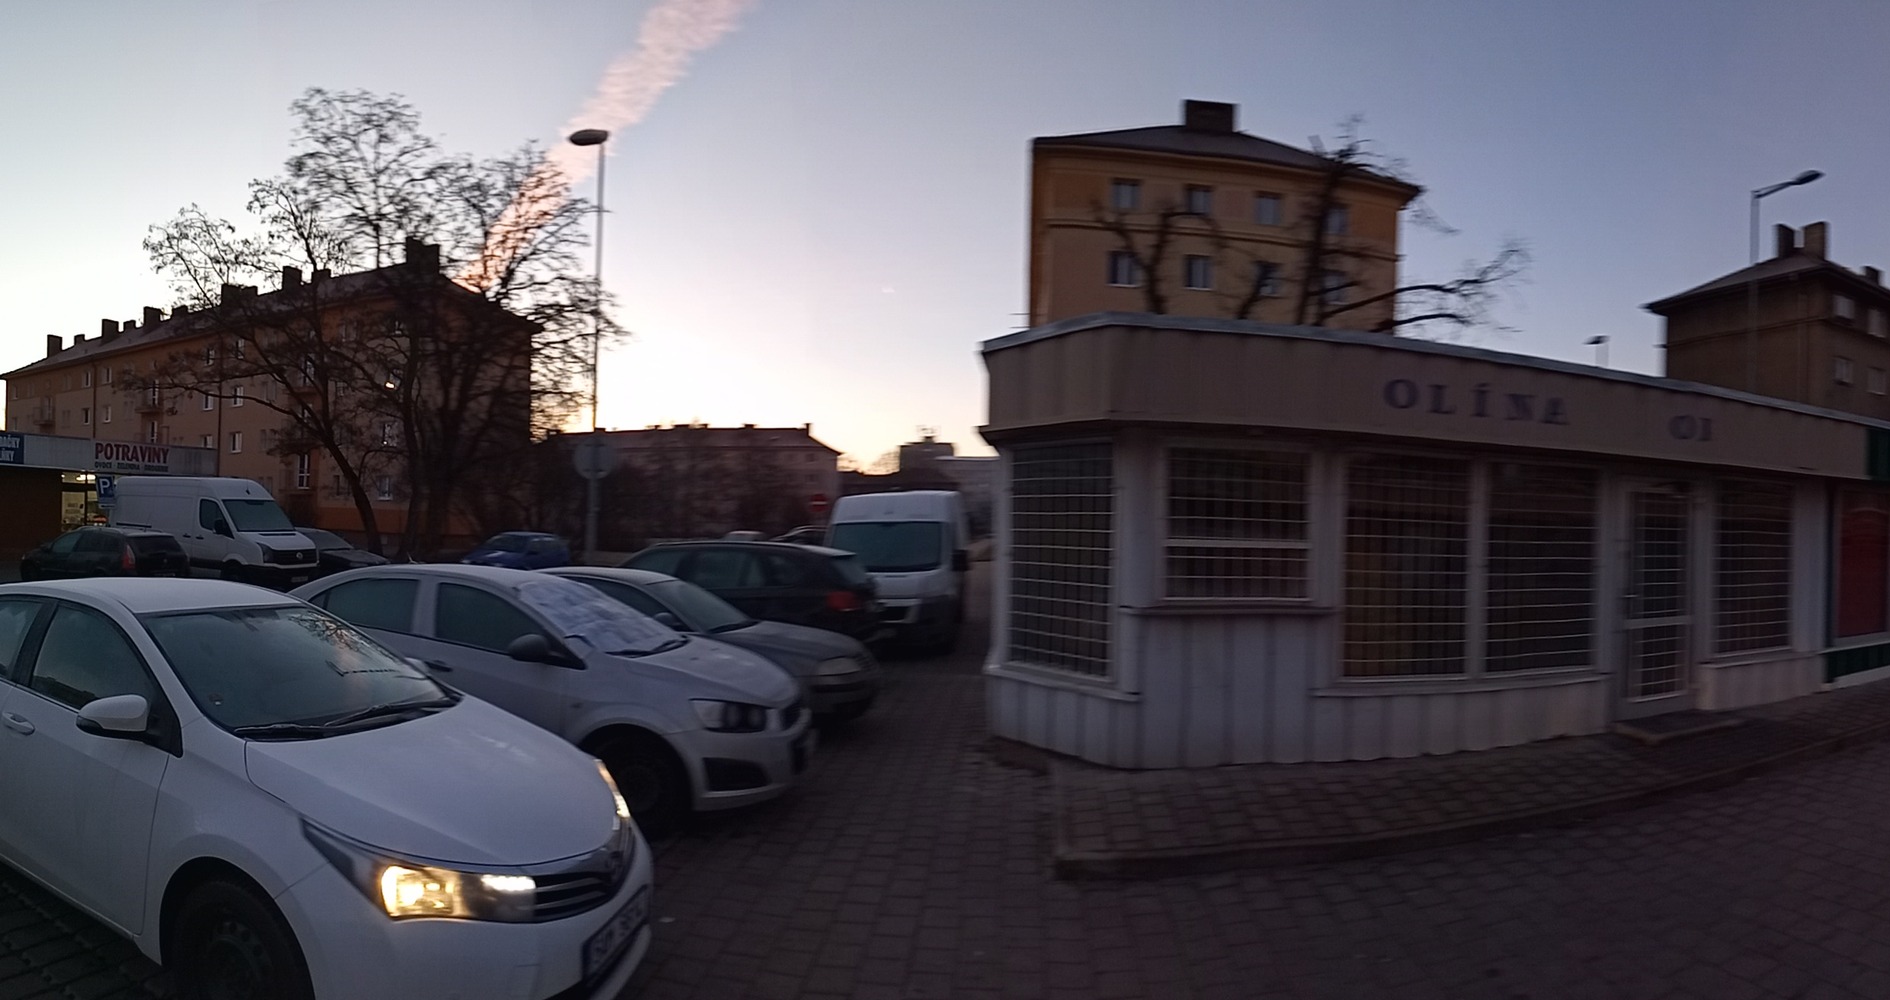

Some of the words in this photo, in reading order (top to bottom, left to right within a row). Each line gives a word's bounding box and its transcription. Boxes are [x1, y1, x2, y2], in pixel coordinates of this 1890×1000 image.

[1383, 378, 1571, 425] OLÍNA
[94, 441, 169, 464] POTRAVINY
[99, 478, 111, 494] P
